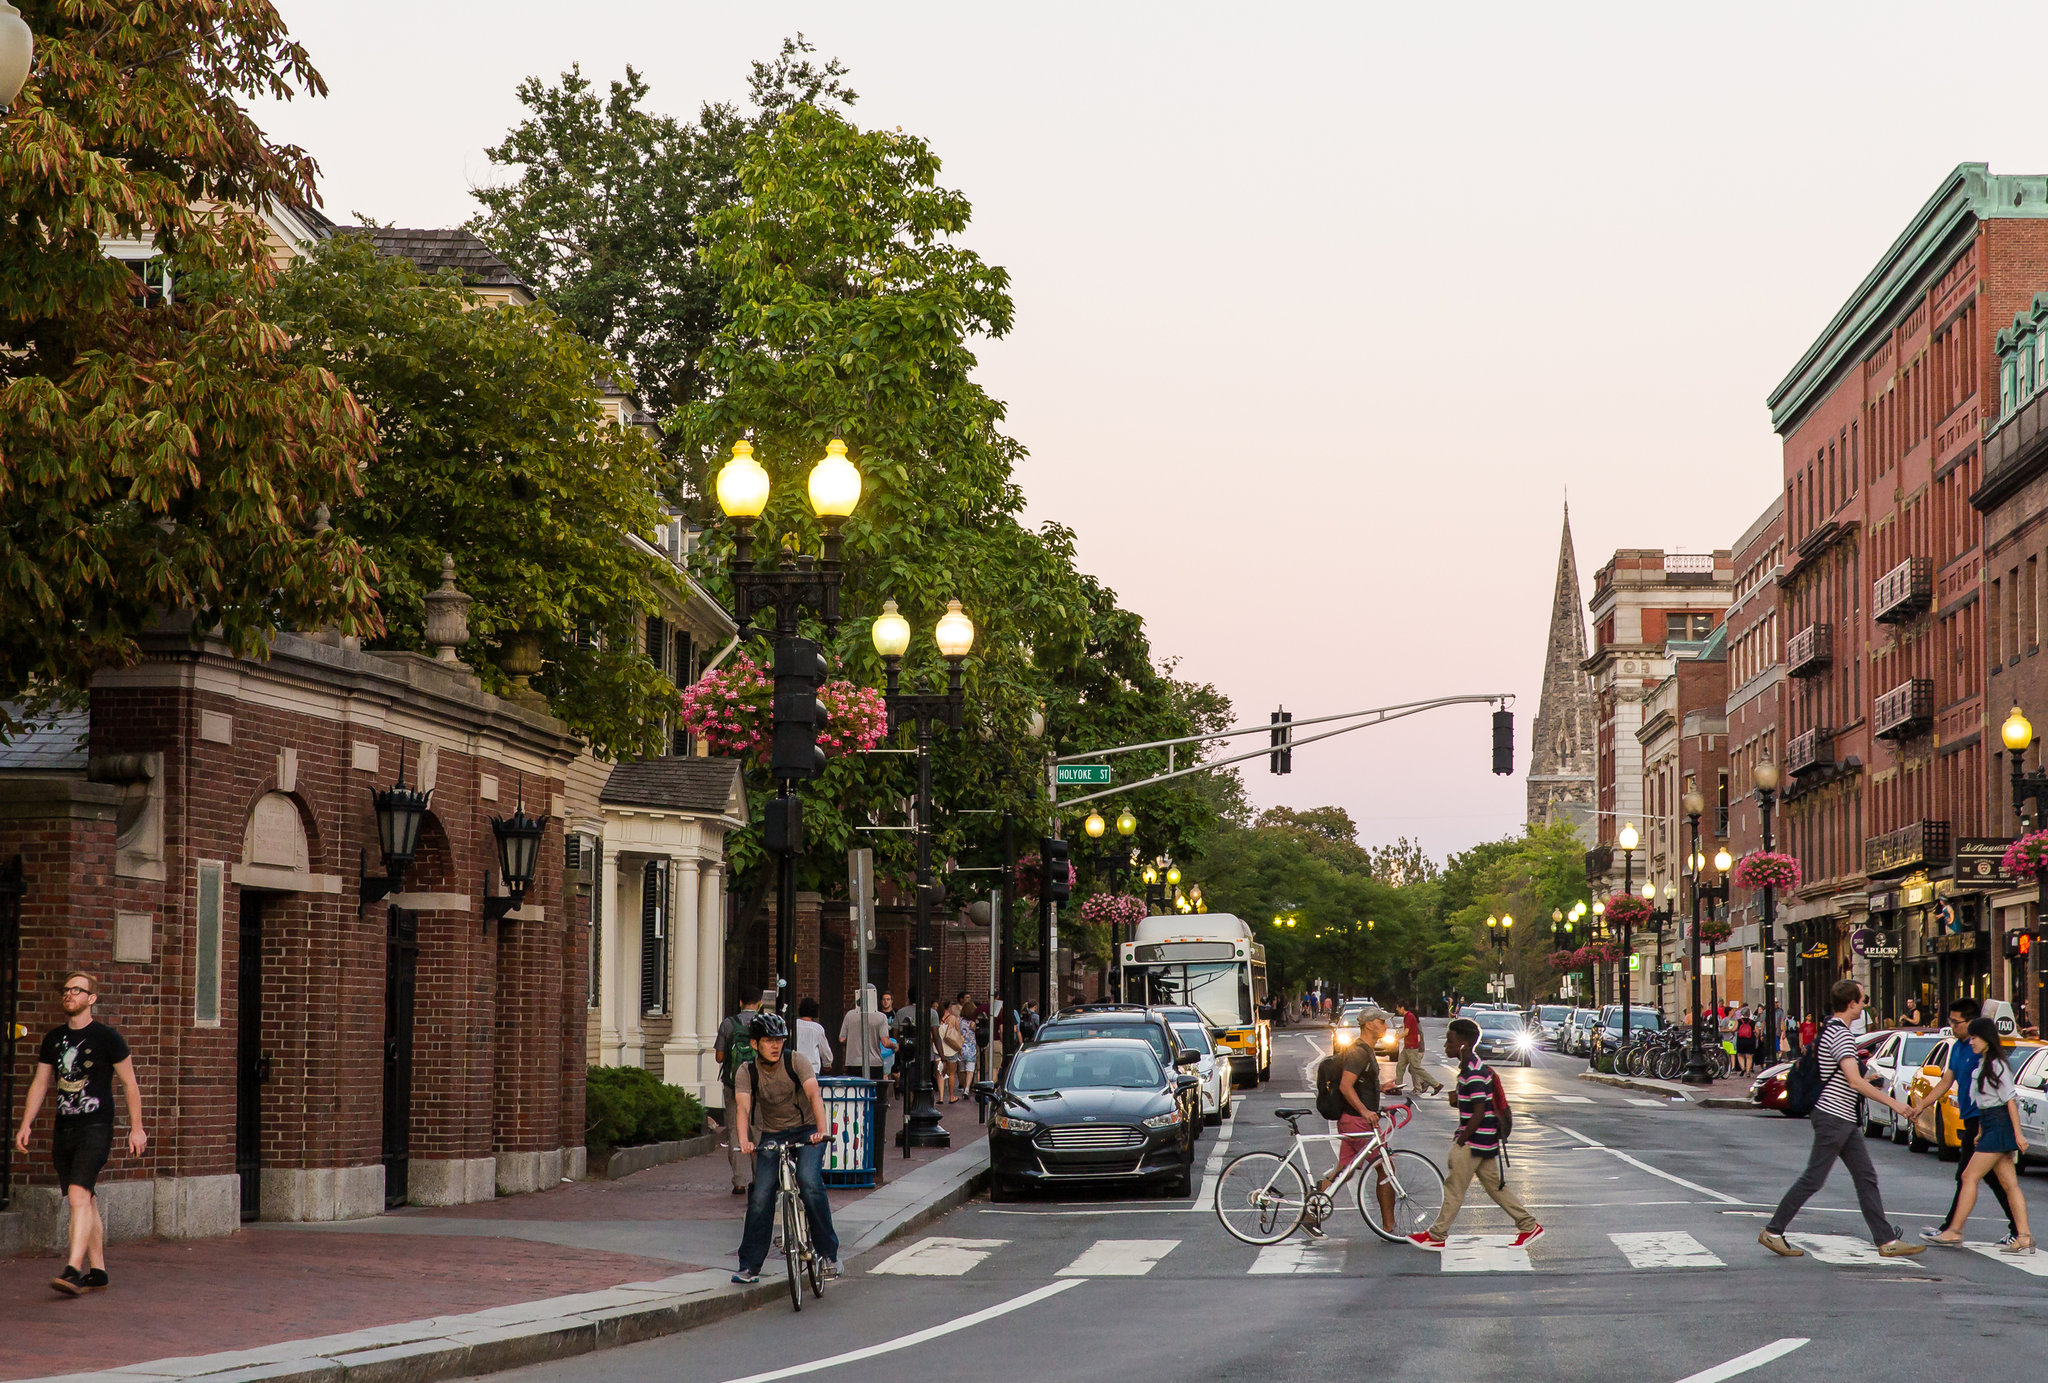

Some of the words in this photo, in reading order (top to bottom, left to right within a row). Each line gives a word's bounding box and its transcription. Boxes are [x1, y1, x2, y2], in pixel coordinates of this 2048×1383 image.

[1059, 769, 1092, 779] HOLYOKE
[1100, 769, 1108, 779] ST
[1997, 1021, 2012, 1031] TAXI
